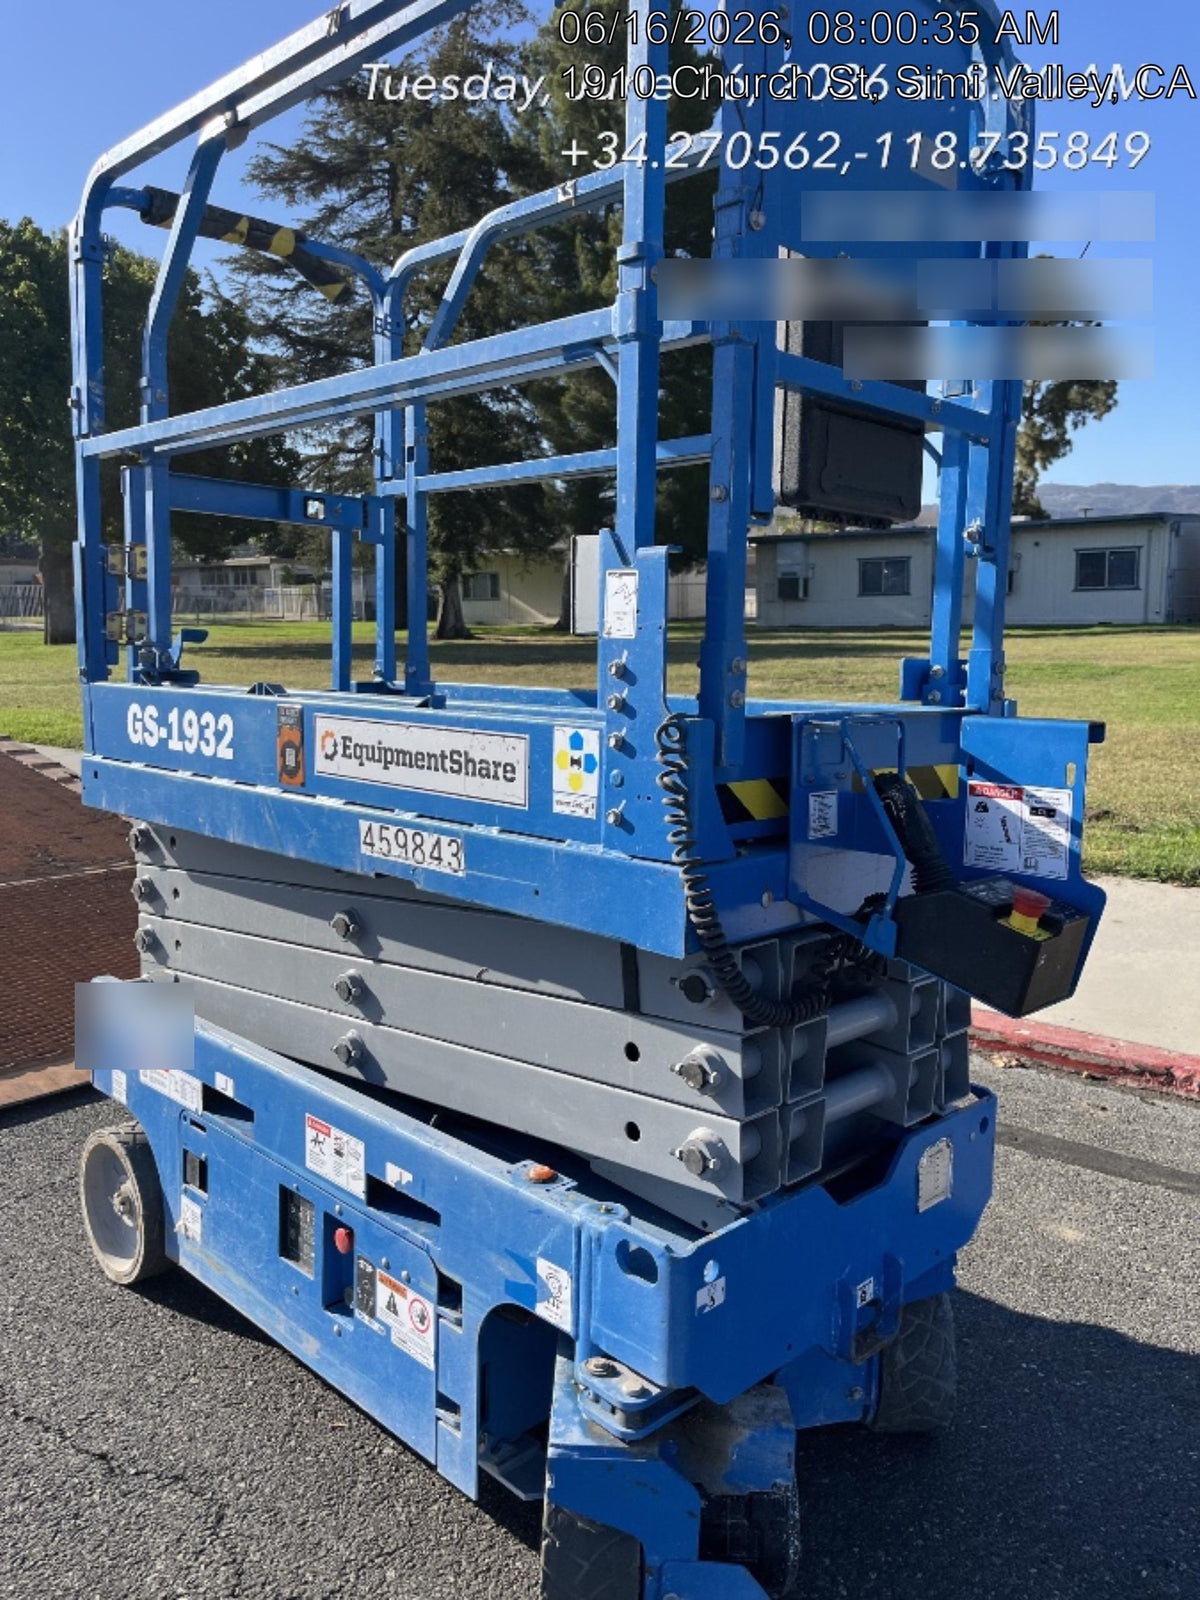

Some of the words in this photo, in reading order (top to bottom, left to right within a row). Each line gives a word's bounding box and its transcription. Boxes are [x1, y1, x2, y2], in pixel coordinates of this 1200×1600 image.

[127, 703, 234, 760] GS-1932
[341, 735, 516, 783] EquipmentShare
[362, 822, 464, 876] 459843
